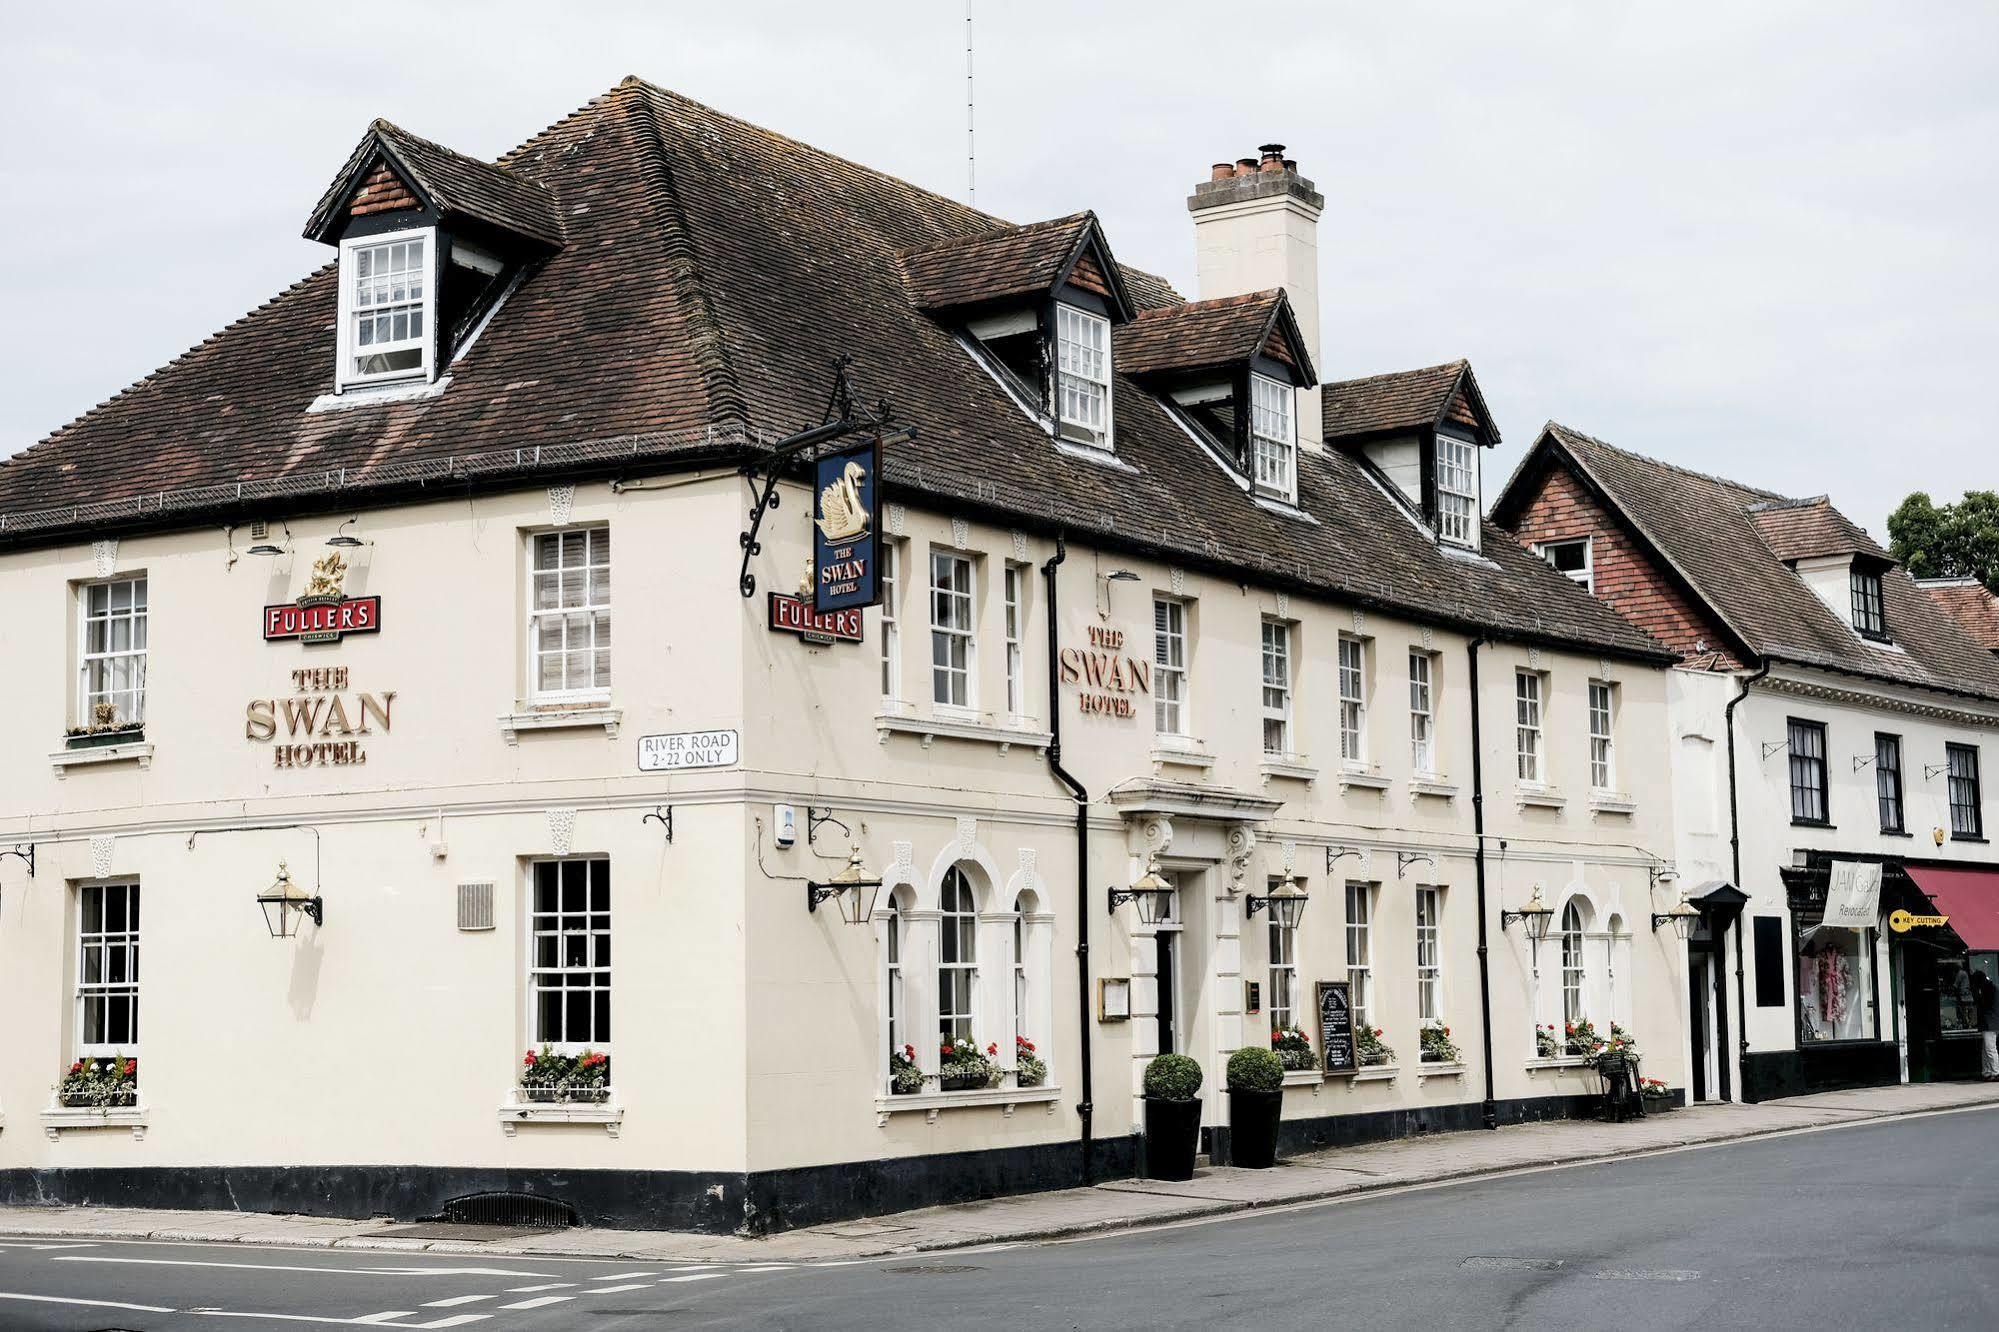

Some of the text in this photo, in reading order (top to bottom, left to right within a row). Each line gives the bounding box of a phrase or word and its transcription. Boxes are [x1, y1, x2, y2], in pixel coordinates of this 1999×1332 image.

[834, 547, 852, 560] THE
[821, 559, 865, 585] SWAN
[829, 582, 857, 596] HOTEL
[270, 603, 368, 632] FULLER'S
[1088, 626, 1124, 649] THE
[291, 666, 349, 690] THE
[1061, 648, 1150, 694] SWAN
[246, 691, 398, 742] SWAN
[1080, 692, 1136, 719] HOTEL
[274, 740, 366, 768] HOTEL
[645, 734, 731, 752] RIVER ROAD
[685, 749, 723, 764] ONLY
